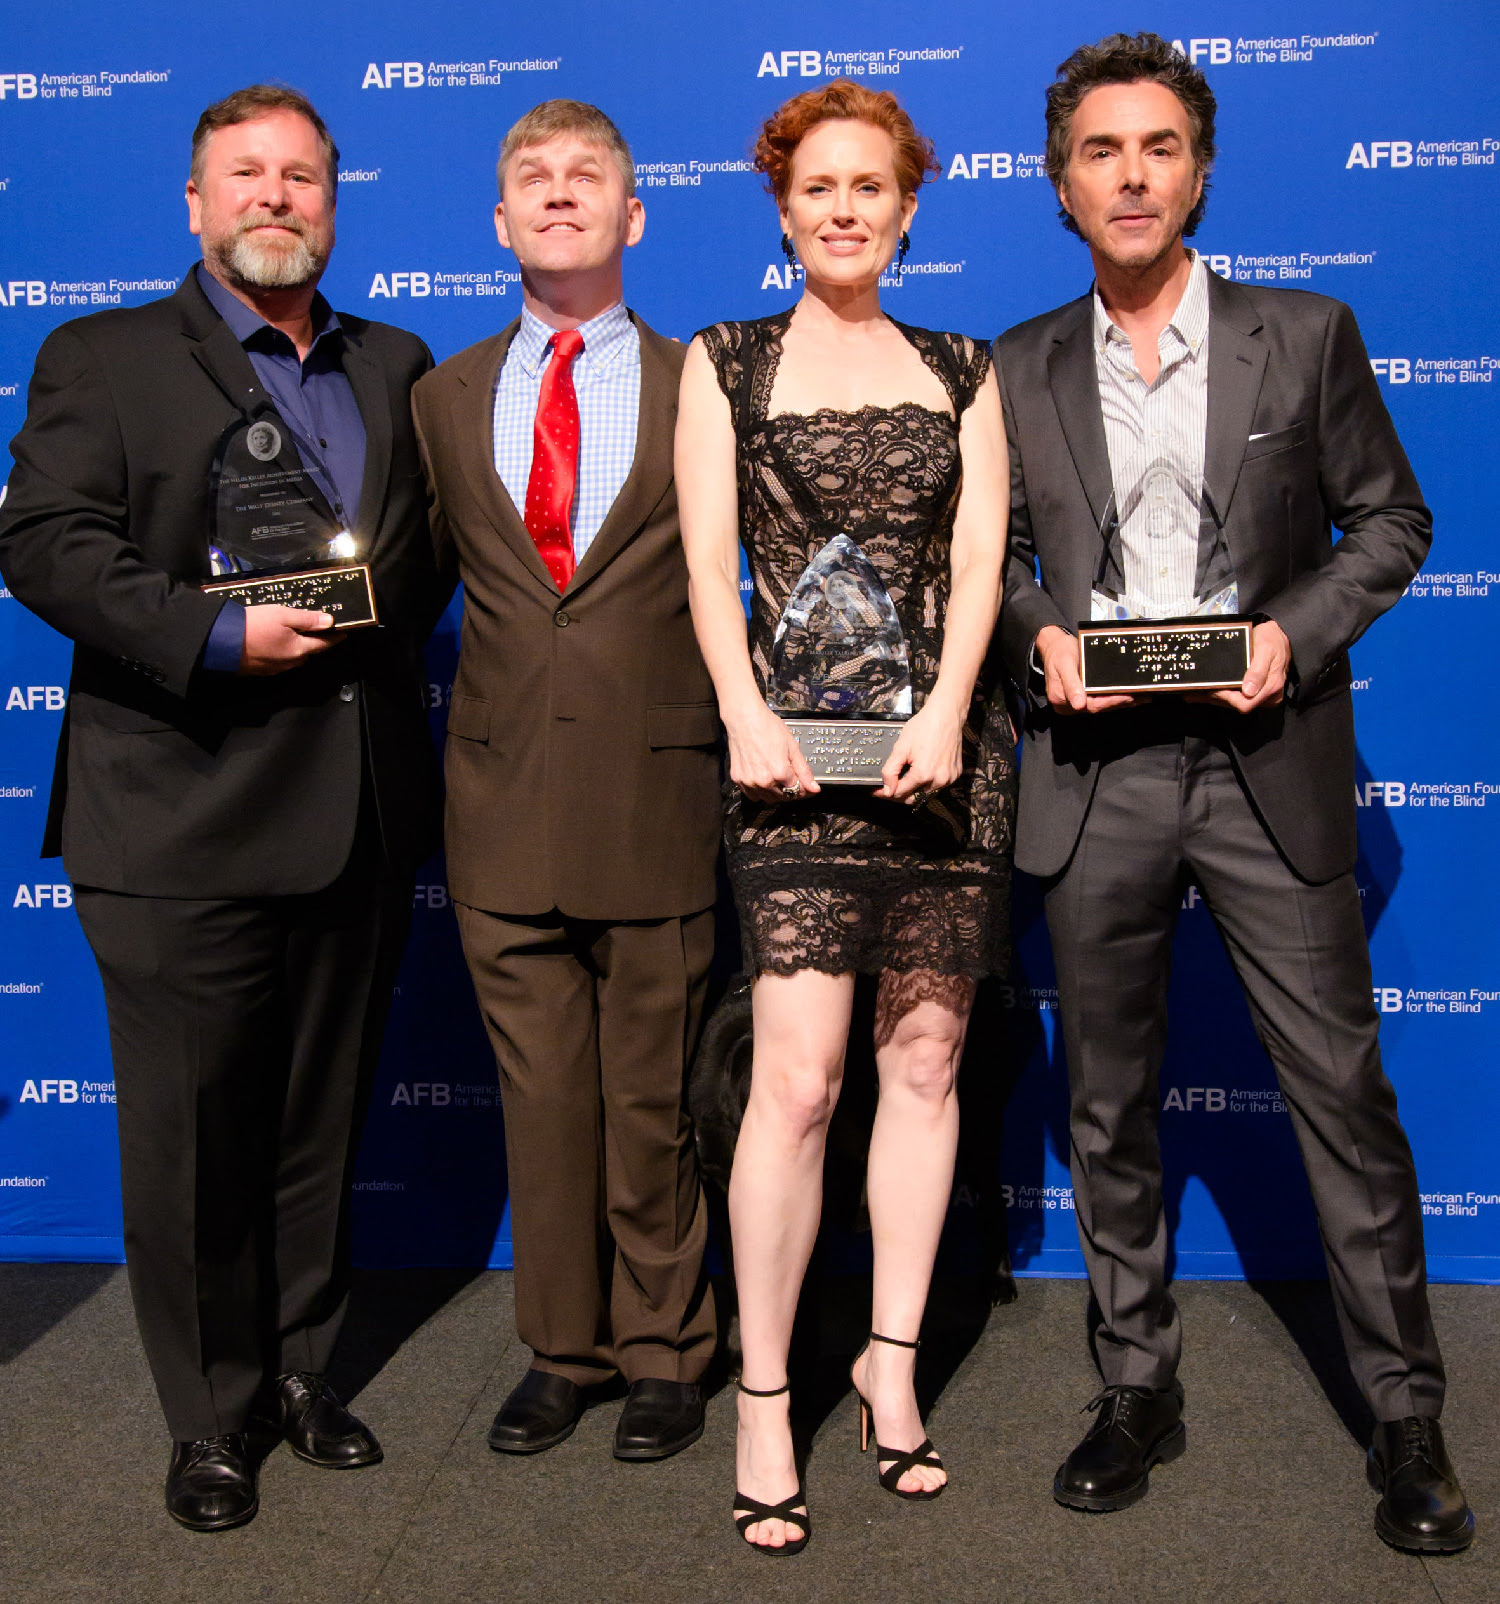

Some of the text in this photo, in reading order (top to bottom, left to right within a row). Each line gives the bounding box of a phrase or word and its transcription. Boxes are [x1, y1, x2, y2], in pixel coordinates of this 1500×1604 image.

[1235, 36, 1297, 50] American
[825, 50, 885, 62] American
[1235, 48, 1313, 63] for the Blind
[427, 61, 486, 74] American
[757, 50, 822, 77] AFB
[825, 62, 900, 76] for the Blind
[40, 72, 97, 86] American
[361, 62, 425, 89] AFB
[427, 73, 500, 87] for the Blind
[0, 73, 38, 100] FB
[40, 84, 112, 98] for the Blind
[1416, 140, 1479, 153] American
[1345, 141, 1413, 169] AFB
[1416, 152, 1494, 167] for the Blind
[947, 152, 1013, 179] AFB
[1016, 166, 1033, 178] for
[338, 168, 379, 182] dation
[634, 173, 701, 187] or the Blind
[1235, 254, 1296, 267] American
[433, 272, 491, 283] American
[761, 263, 806, 289] AF
[1235, 266, 1311, 280] for the Blind
[50, 281, 106, 292] American
[368, 272, 431, 298] AFB
[434, 283, 506, 296] for the Blind
[50, 292, 121, 305] for the Blind
[1415, 357, 1477, 370] American
[1370, 358, 1412, 384] FB
[1414, 370, 1492, 383] for the Blind
[1411, 572, 1476, 586] American
[1411, 586, 1429, 597] for
[1432, 585, 1453, 597] the
[1456, 584, 1488, 597] Blind
[5, 686, 65, 710] AFB
[0, 783, 37, 798] dation
[1409, 782, 1471, 794] American
[1409, 794, 1485, 807] for the Blind
[13, 884, 72, 908] AFB
[413, 885, 447, 908] FB
[0, 981, 43, 995] ndation
[1406, 988, 1466, 1001] American
[1406, 1001, 1481, 1013] for the Blind
[19, 1079, 79, 1103] AFB
[81, 1080, 115, 1091] Ameri
[455, 1082, 501, 1097] America
[81, 1092, 117, 1104] for the
[391, 1083, 451, 1106] AFB
[454, 1096, 468, 1106] for
[473, 1096, 492, 1106] the
[1163, 1088, 1226, 1112] AFB
[1230, 1089, 1281, 1100] America
[1230, 1099, 1289, 1114] for the Bli
[0, 1174, 47, 1190] undation
[1018, 1198, 1074, 1209] for the Bli
[1419, 1192, 1463, 1204] merican
[1422, 1203, 1478, 1216] the Blind
